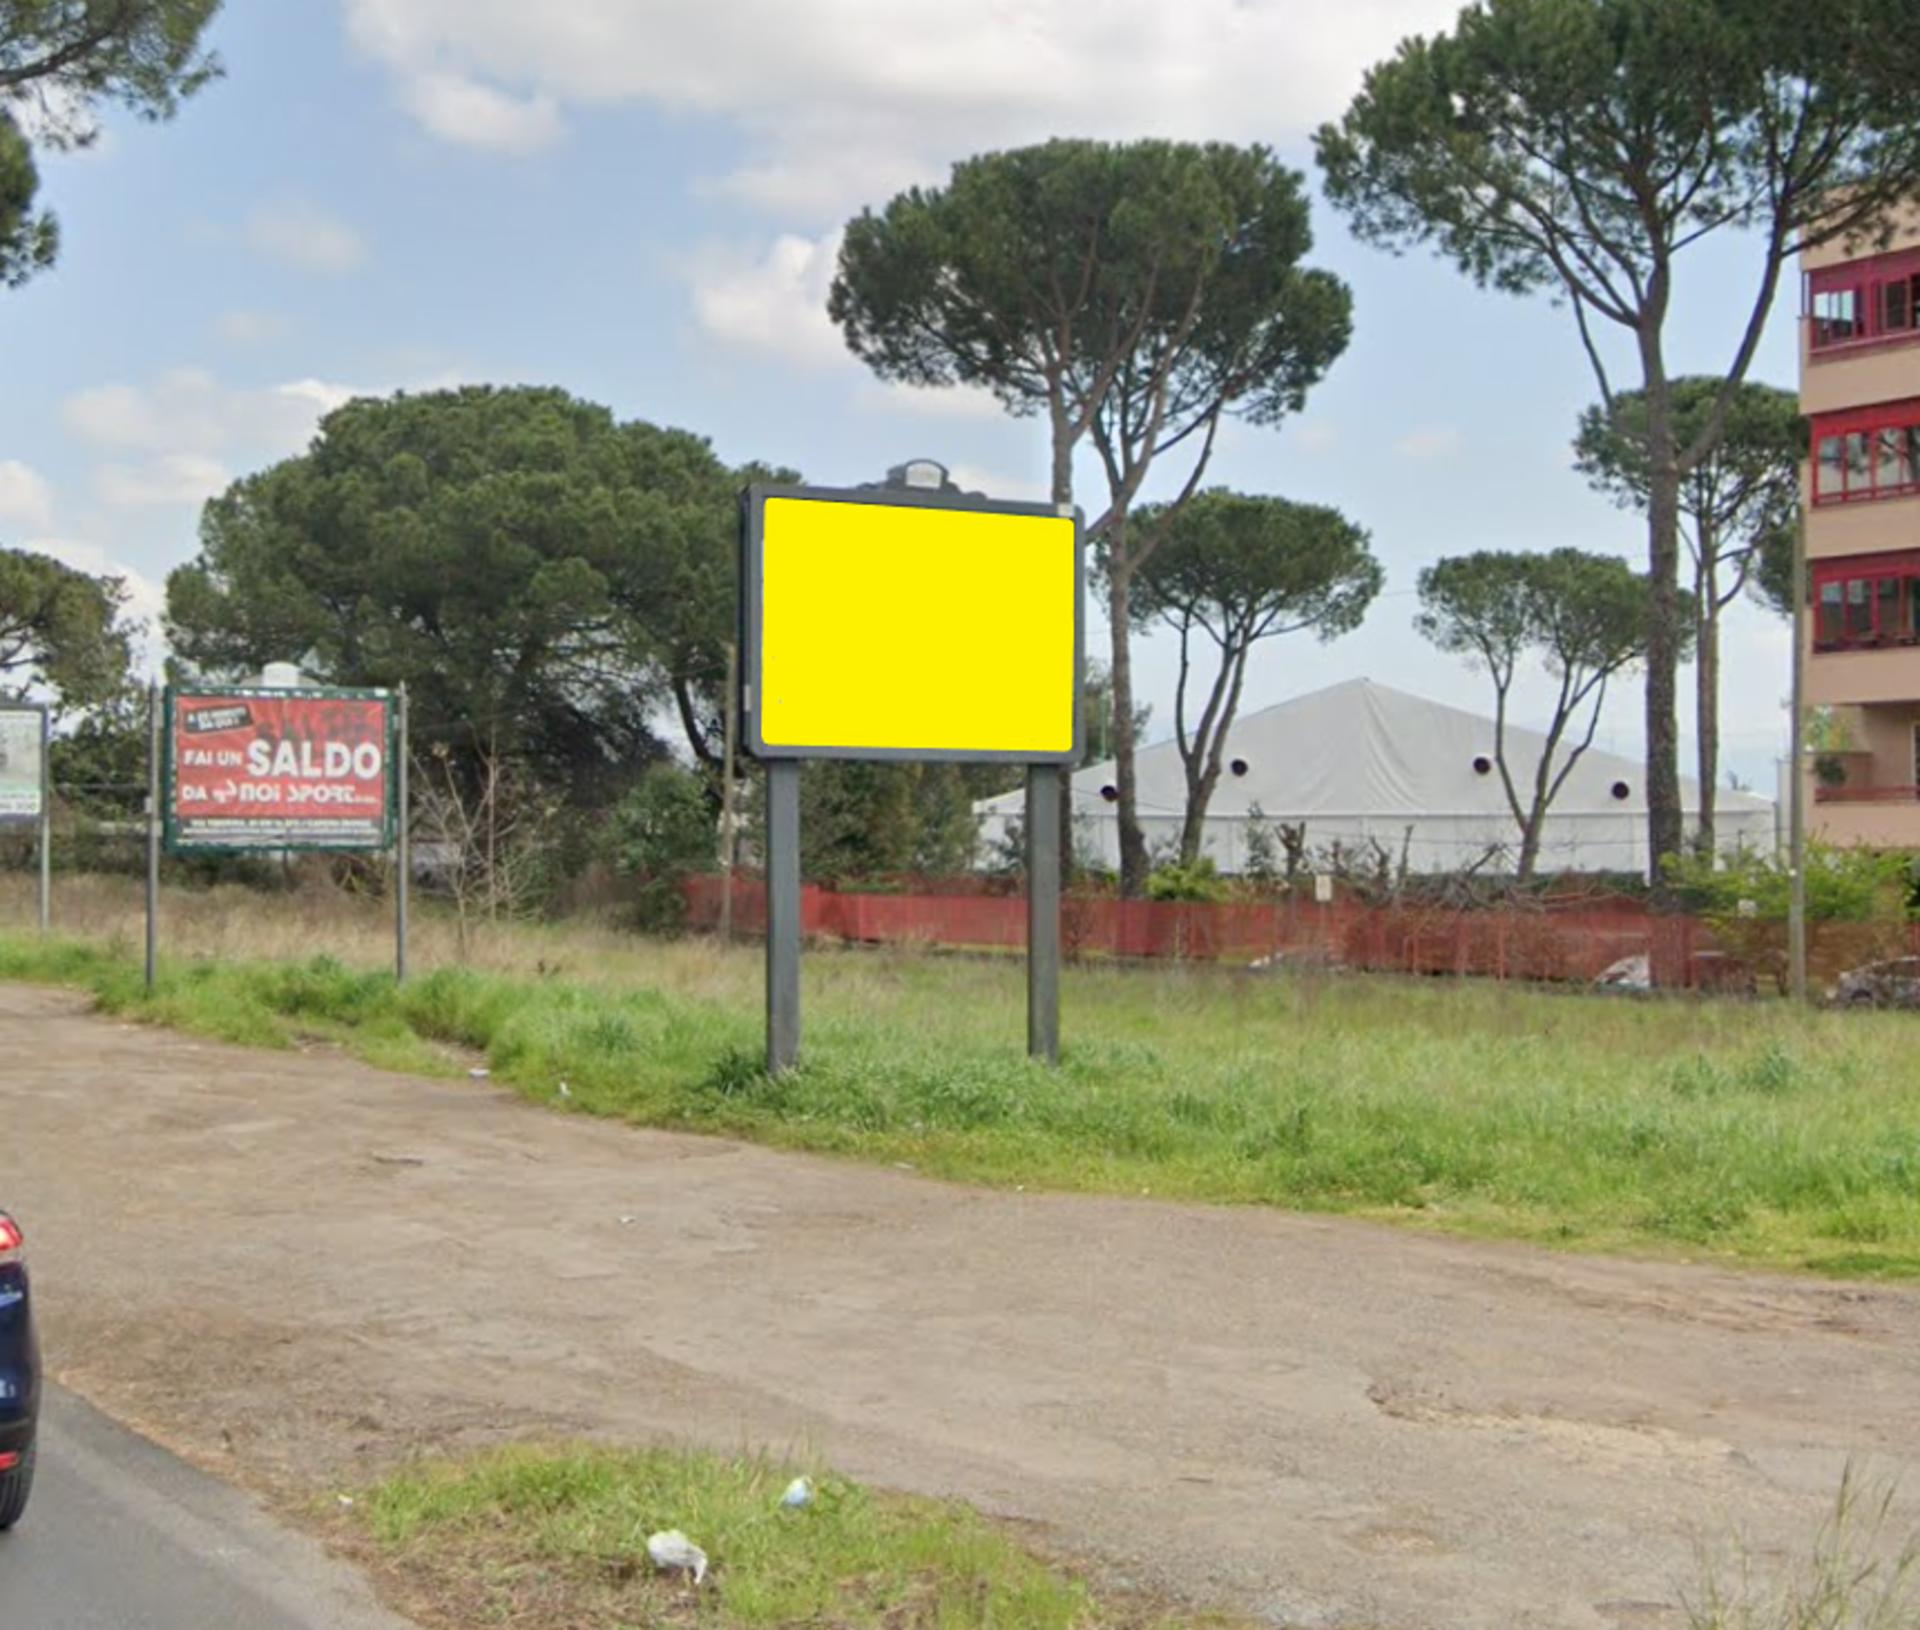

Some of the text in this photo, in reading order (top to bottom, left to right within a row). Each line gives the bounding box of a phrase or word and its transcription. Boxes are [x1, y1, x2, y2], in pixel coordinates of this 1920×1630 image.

[184, 738, 382, 780] FAI UN SALDO
[181, 785, 208, 801] DA
